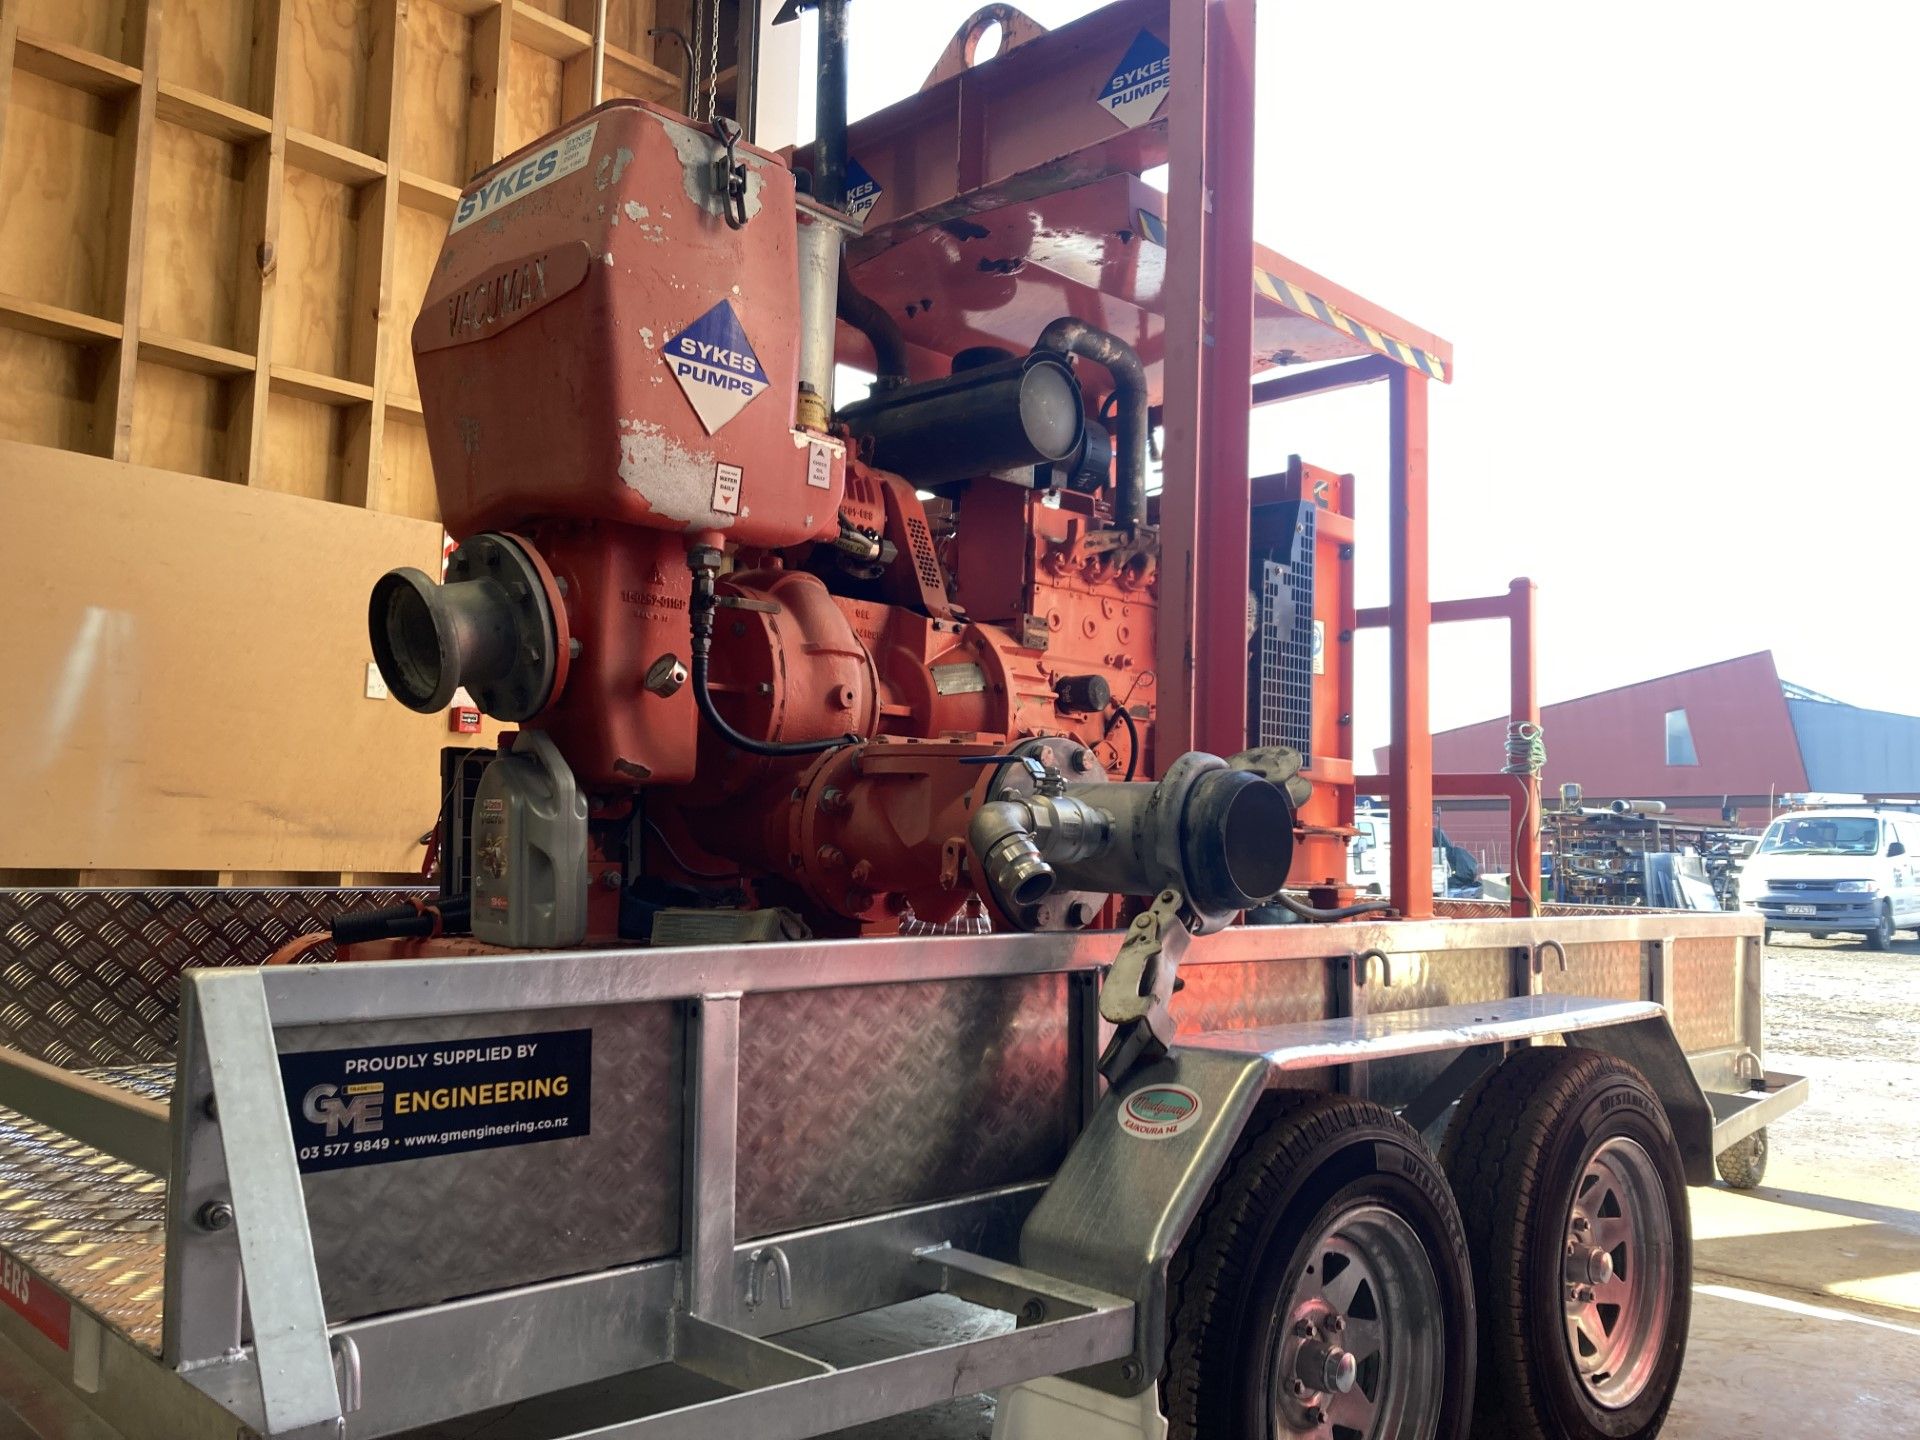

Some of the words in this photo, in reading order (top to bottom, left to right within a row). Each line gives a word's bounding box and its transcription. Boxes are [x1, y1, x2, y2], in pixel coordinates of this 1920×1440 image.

[1112, 56, 1169, 90] SYKES
[1111, 76, 1169, 109] PUMPS
[457, 150, 558, 223] SYKES
[448, 255, 548, 337] VACUMAX
[680, 337, 756, 374] SYKES
[677, 362, 753, 396] PUMPS
[345, 1053, 428, 1074] PROUDLY
[433, 1046, 512, 1066] SUPPLIED
[517, 1043, 538, 1058] BY
[395, 1076, 569, 1115] ENGINEERING
[300, 1145, 320, 1160] 03
[323, 1142, 350, 1157] 577
[353, 1137, 390, 1153] 9849
[404, 1117, 569, 1147] www.gmengineering.co.nz
